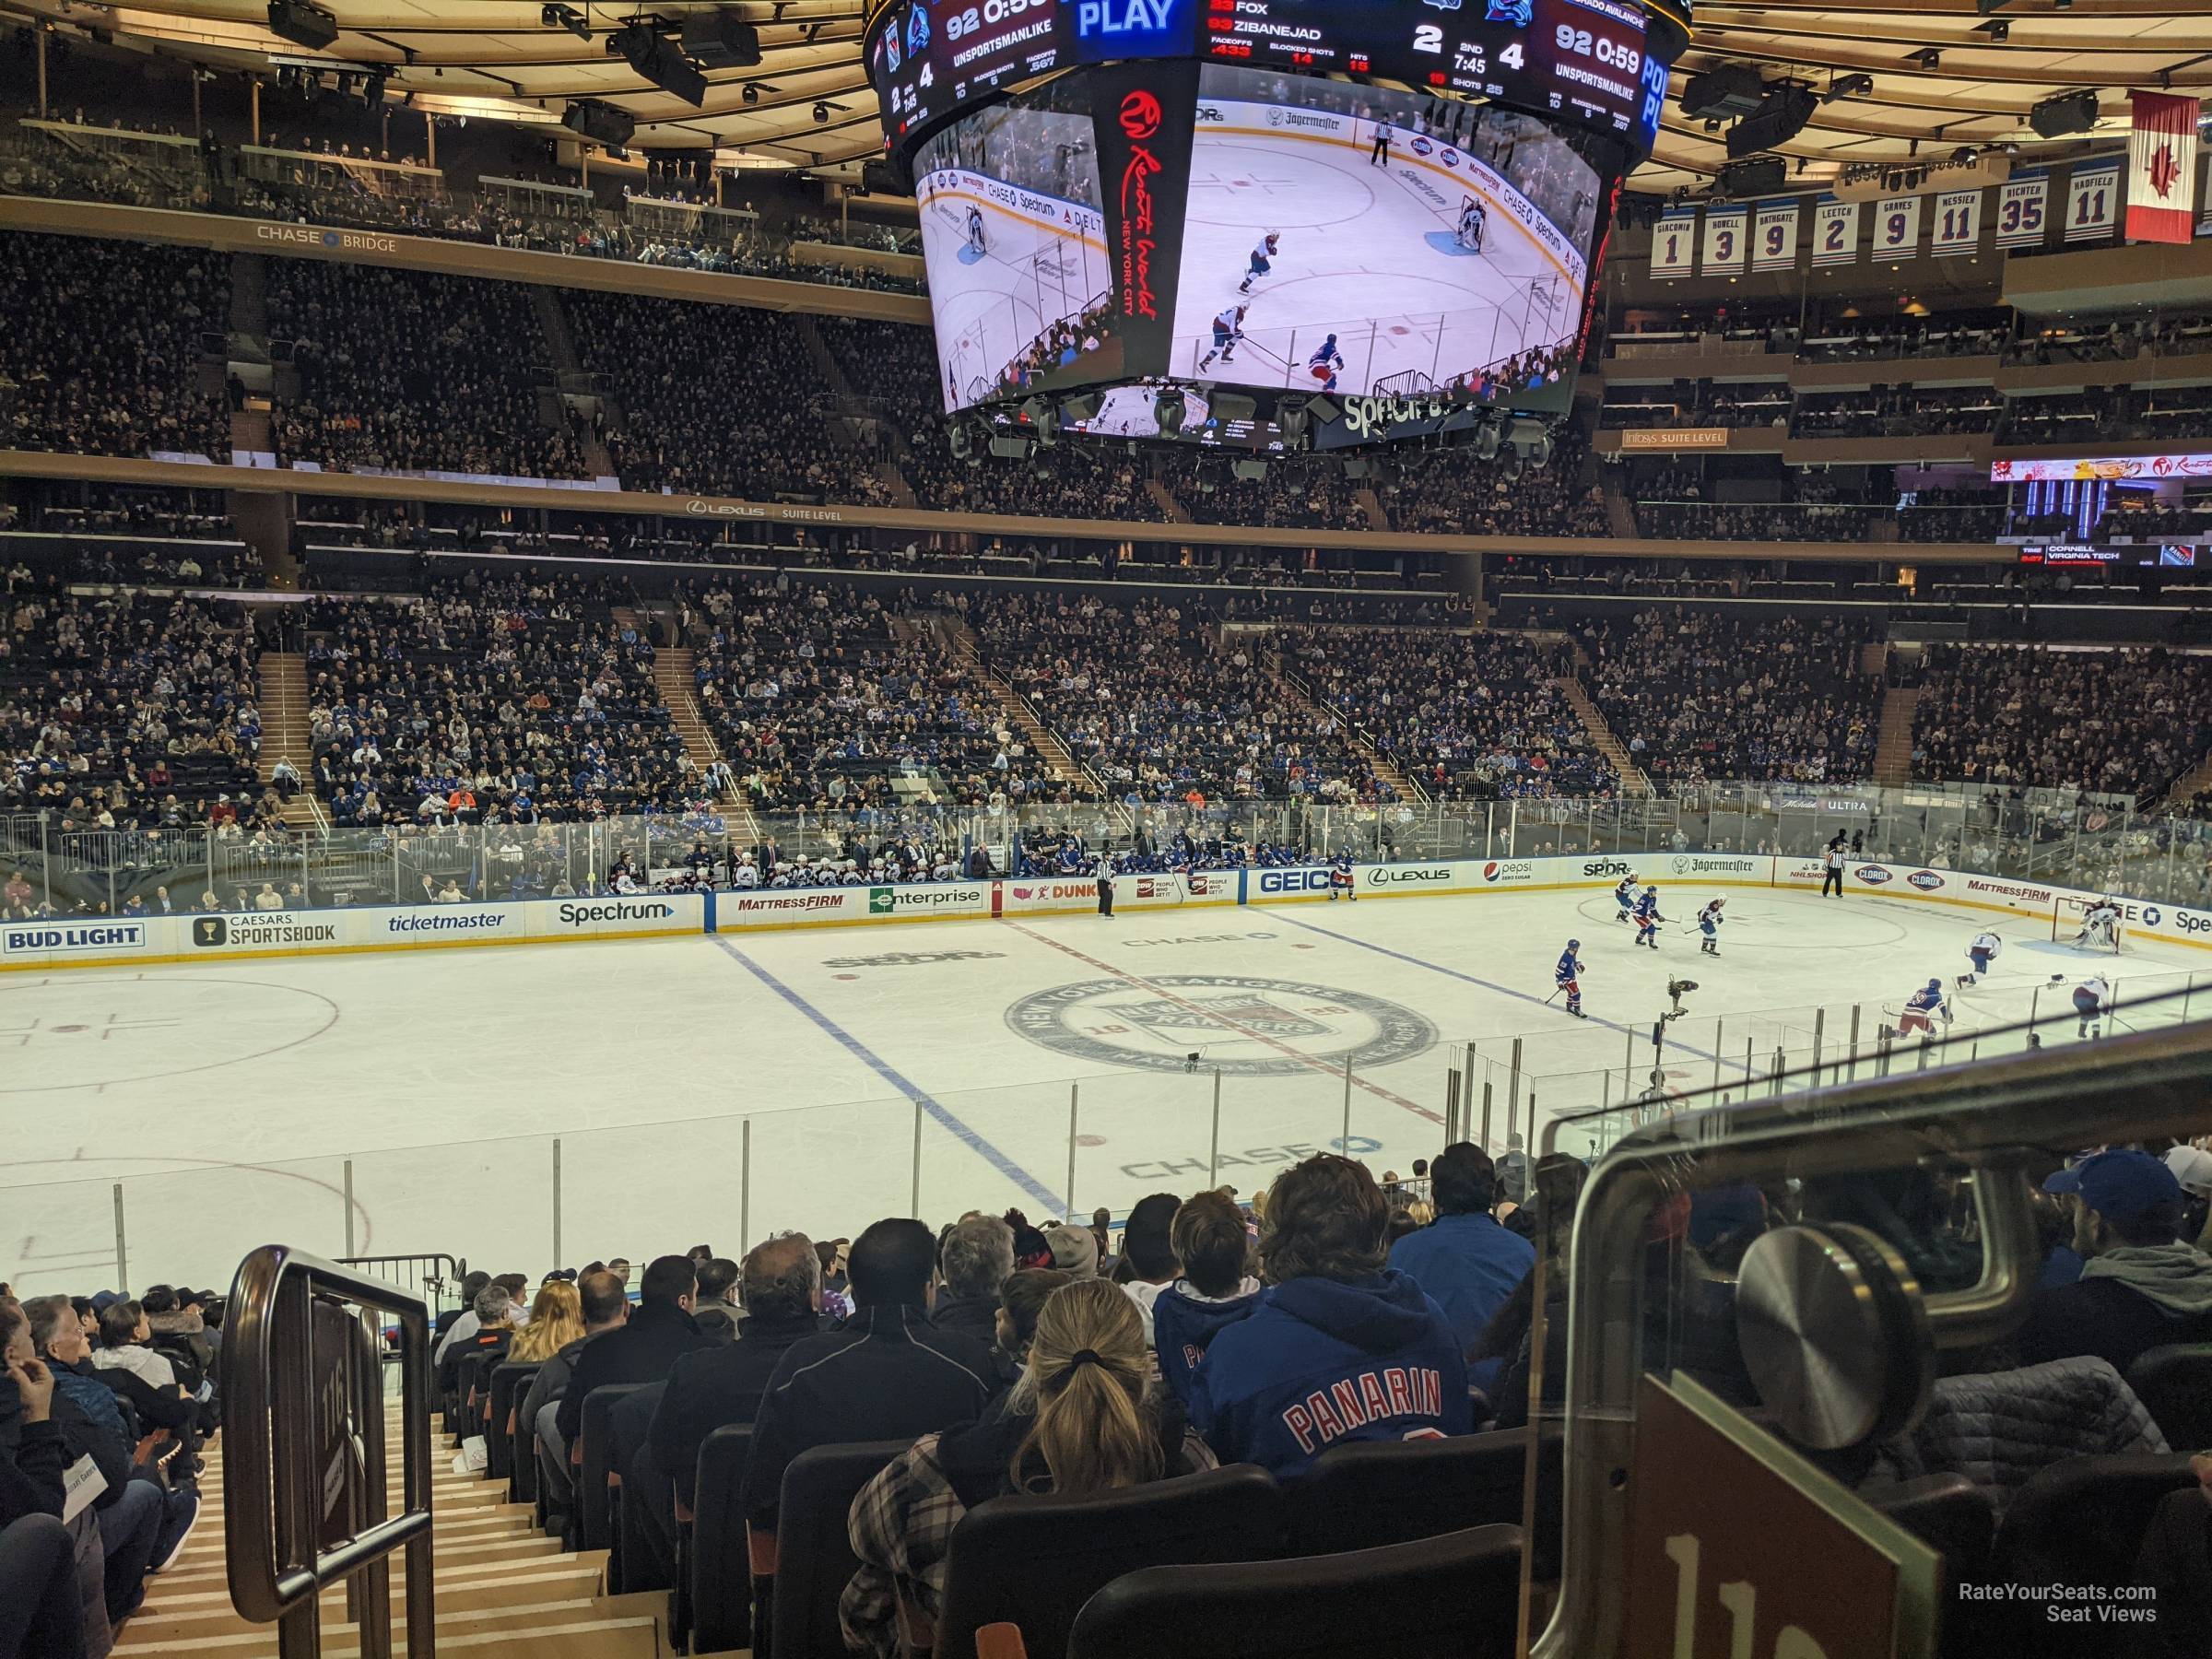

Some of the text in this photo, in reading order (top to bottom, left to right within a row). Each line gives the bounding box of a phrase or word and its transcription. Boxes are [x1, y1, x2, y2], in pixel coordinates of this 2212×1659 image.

[1236, 1, 1268, 15] FOX
[1605, 6, 1645, 29] AVALANCHE
[947, 8, 981, 41] 92
[1078, 0, 1175, 38] PLAY
[1208, 18, 1322, 41] 93 ZIBANEJAD
[953, 18, 1053, 67] UNSPORTSMANLIKE
[1211, 36, 1253, 47] FACEOFFS
[1413, 24, 1443, 53] 2
[1460, 42, 1483, 54] 2ND
[1556, 24, 1640, 74] 92 0:59
[1269, 42, 1335, 57] BLOCKED SHOTS
[1292, 53, 1312, 65] 14
[1350, 53, 1368, 64] HITS
[1499, 43, 1524, 70] 4
[920, 62, 934, 88] 4
[1030, 56, 1055, 73] .567
[1453, 54, 1486, 75] 7:45
[990, 76, 998, 86] 5
[1453, 77, 1481, 90] SHOTS
[1486, 83, 1503, 96] 25
[1556, 64, 1635, 101] UNSPORTSMANLIKE
[891, 86, 900, 114] 2
[956, 88, 966, 100] 10
[1549, 99, 1560, 110] 10
[1584, 109, 1592, 118] 5
[988, 183, 1010, 204] CHASE
[1399, 169, 1447, 206] Spectrum
[2006, 184, 2042, 199] RICHTER
[2074, 176, 2113, 191] HADFIELD
[1019, 194, 1053, 217] Spectrum
[1503, 188, 1527, 219] CHASE
[1822, 206, 1853, 219] LEETCH
[1884, 200, 1913, 213] GRAVES
[2076, 189, 2106, 225] 11
[1712, 218, 1740, 229] HOWELL
[1759, 213, 1794, 226] BATHGATE
[1941, 206, 1971, 241] 11
[2000, 197, 2043, 233] 35
[1535, 217, 1560, 251] Spectrum
[1825, 219, 1845, 252] 2
[1887, 213, 1906, 244] 9
[257, 226, 396, 253] CHASE BRIDGE
[1665, 234, 1678, 265] 1
[1714, 230, 1735, 262] 3
[1765, 225, 1784, 256] 9
[1122, 219, 1133, 317] NEW YORK CITY
[1136, 239, 1158, 318] World
[1203, 429, 1214, 439] 4
[1626, 432, 1723, 445] Infosys SUITE LEVEL
[708, 505, 842, 522] LEXUS SUITE LEVEL
[1828, 800, 1867, 811] ULTRA
[1392, 870, 1450, 881] LEXUS
[1502, 861, 1532, 875] pepsi
[1859, 869, 1888, 881] CLOROX
[1912, 875, 1941, 887] CLOROX
[230, 914, 292, 926] CAESARS
[388, 912, 505, 932] ticketmaster
[559, 902, 668, 926] Spectrum
[9, 927, 140, 948] BUD LIGHT
[230, 925, 335, 945] SPORTSBOOK
[1121, 934, 1239, 947] CHASE
[1022, 977, 1341, 1029] NEW YORK RANGERS
[1120, 1143, 1317, 1179] CHASE
[1282, 1366, 1442, 1455] PANARIN
